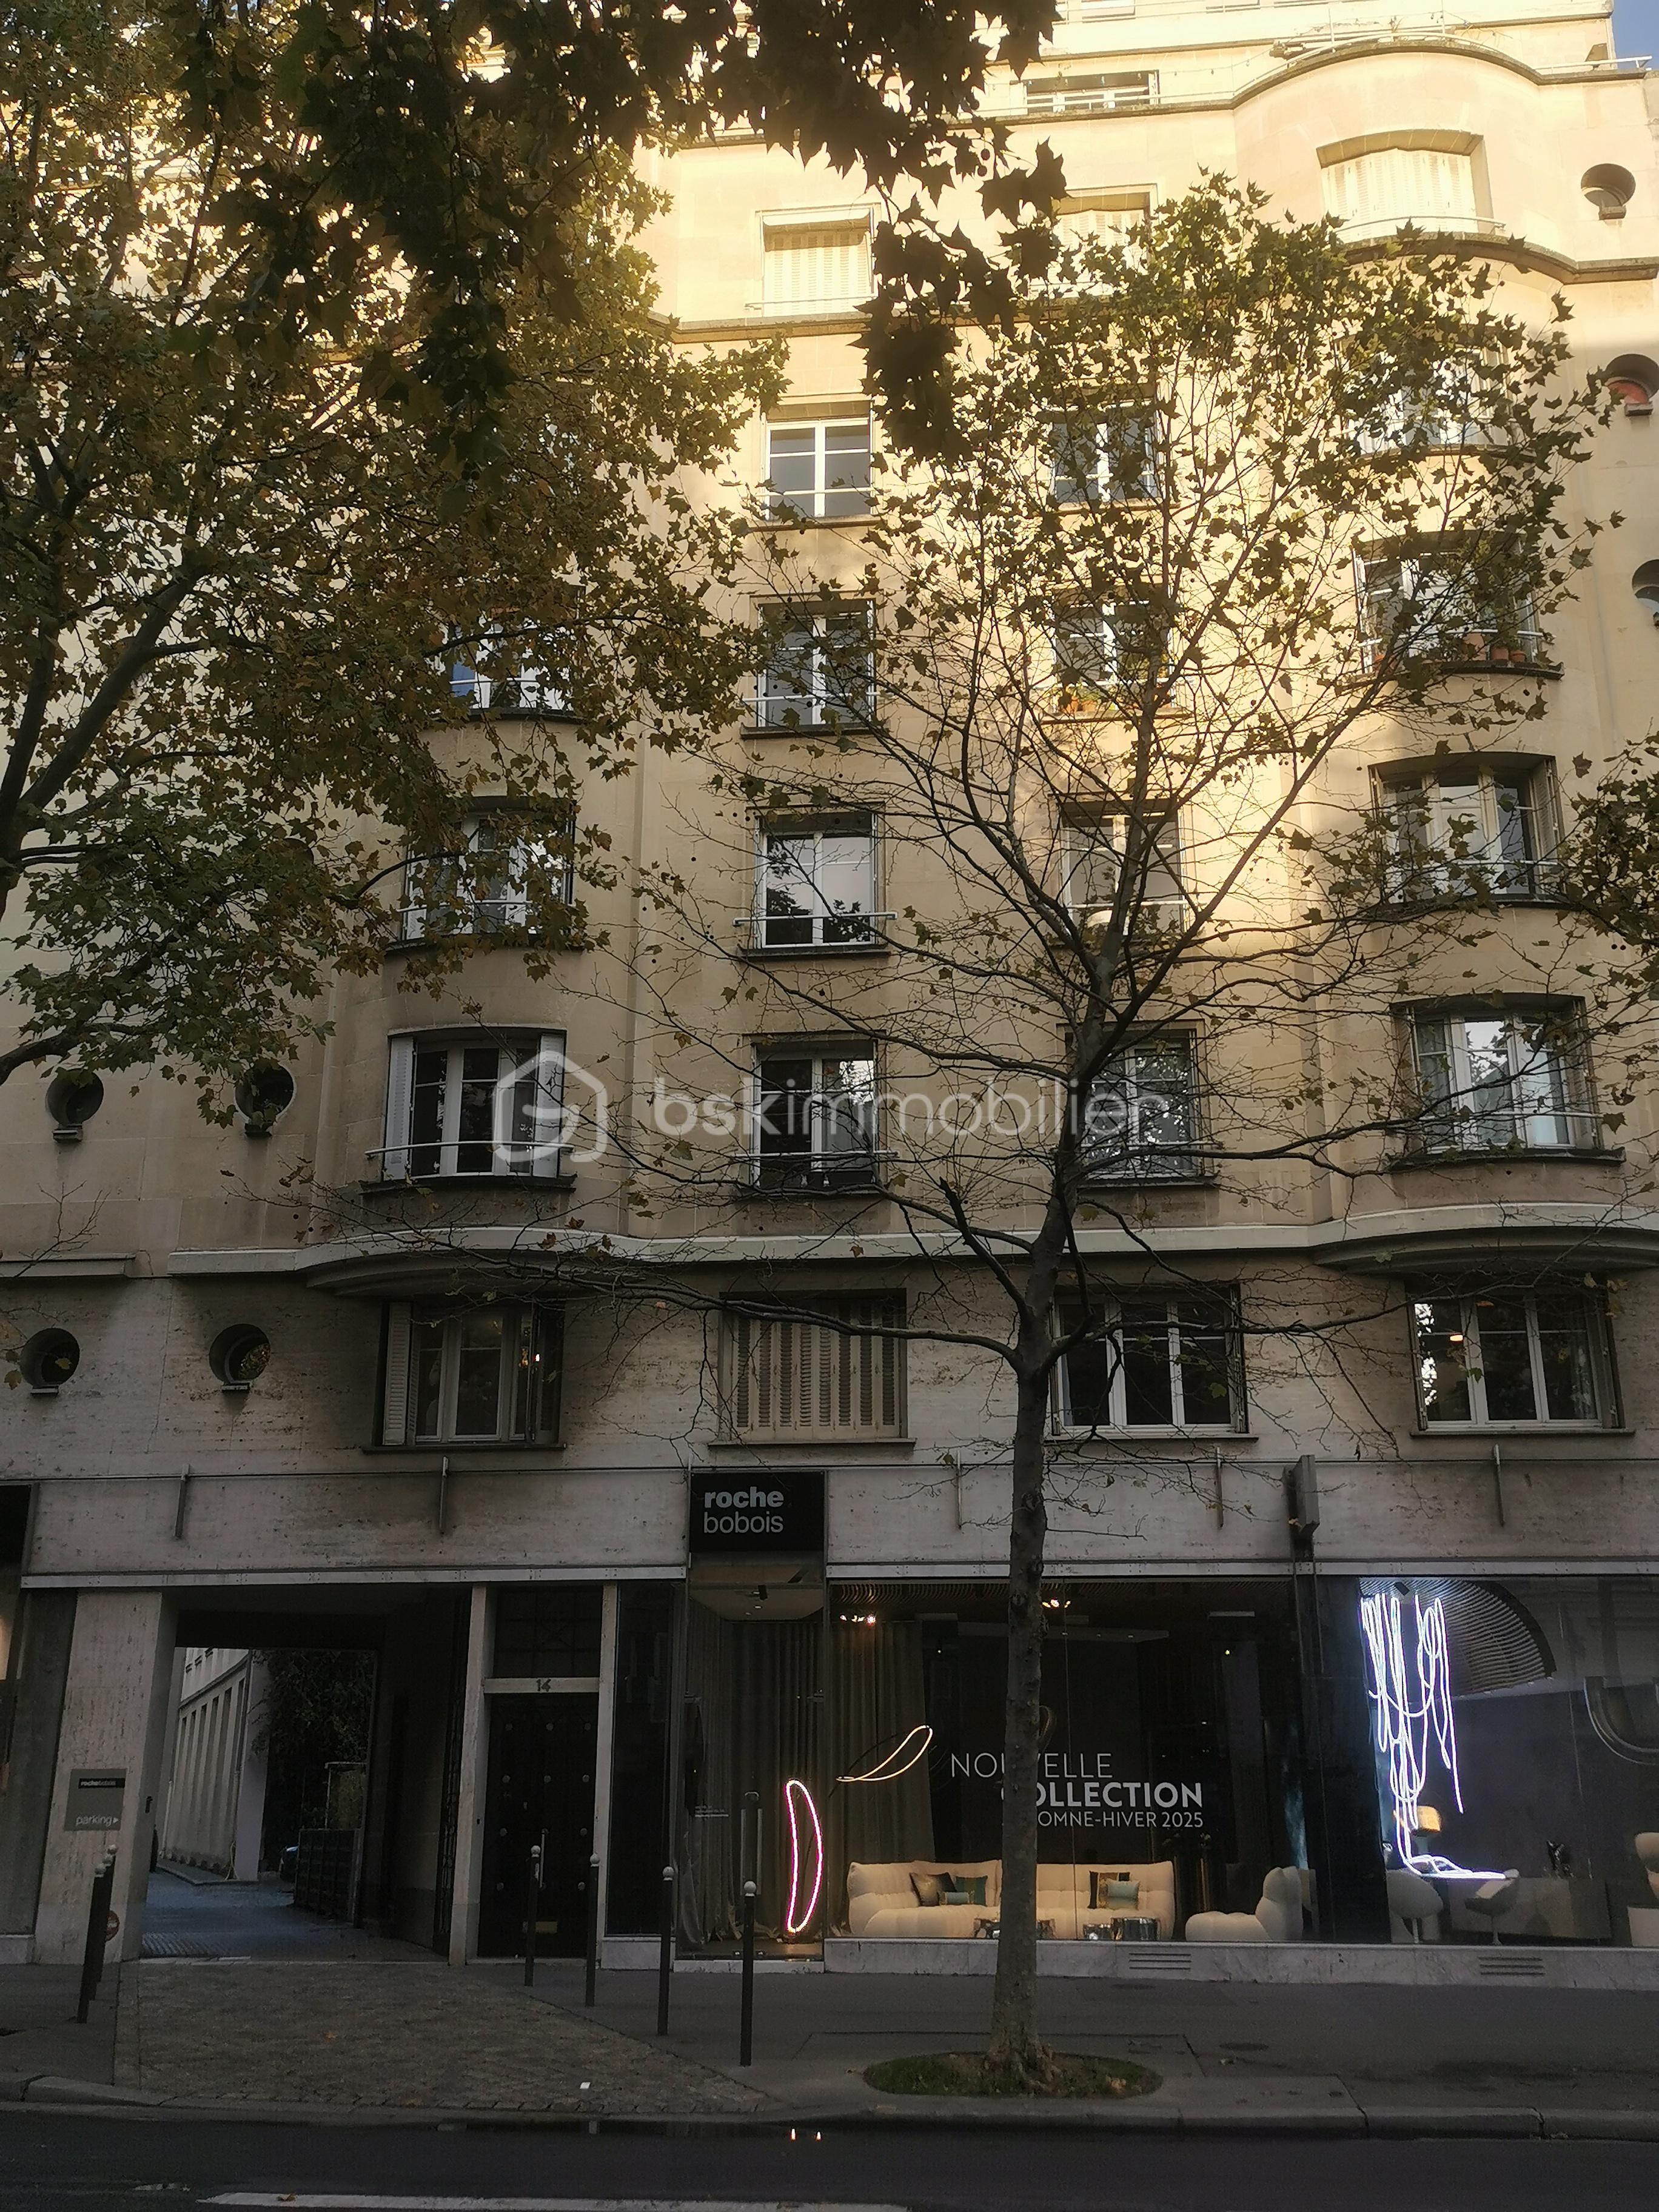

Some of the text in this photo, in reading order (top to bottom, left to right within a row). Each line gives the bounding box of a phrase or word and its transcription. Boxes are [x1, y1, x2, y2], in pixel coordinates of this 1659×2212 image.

[704, 1486, 785, 1509] roche
[703, 1510, 784, 1533] bobois
[951, 1752, 1113, 1778] NOELLE
[1000, 1781, 1203, 1808] LLECTION
[75, 1815, 112, 1828] parking
[1161, 1811, 1204, 1828] 2025
